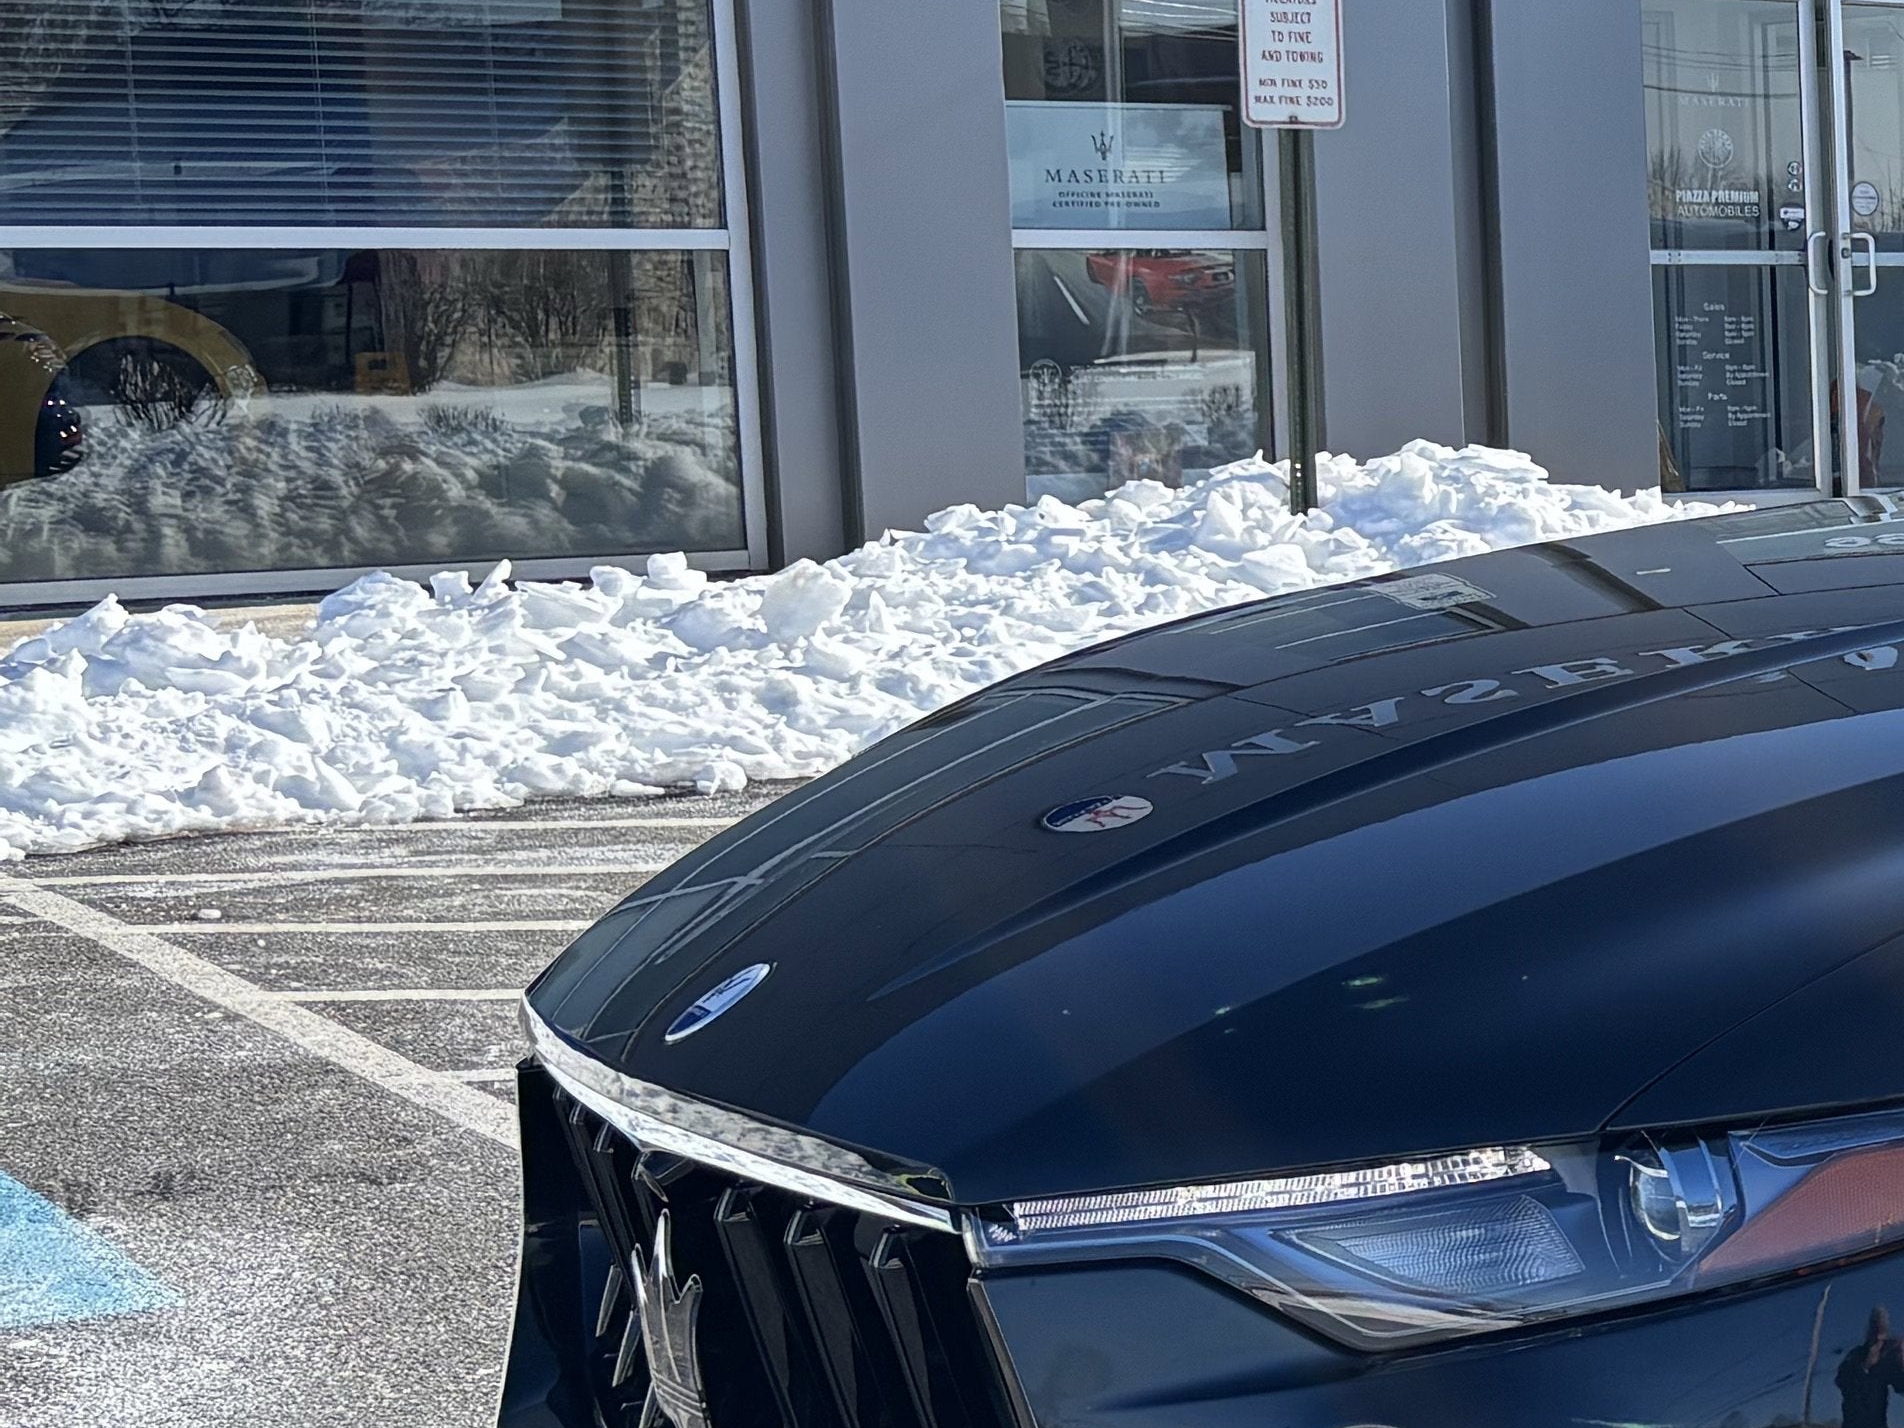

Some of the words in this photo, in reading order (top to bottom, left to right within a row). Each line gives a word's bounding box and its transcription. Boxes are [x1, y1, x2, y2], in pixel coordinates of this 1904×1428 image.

[1270, 12, 1311, 24] SUBJECT
[1271, 30, 1284, 42] TO
[1288, 31, 1312, 44] FINE
[1261, 50, 1282, 62] AND
[1285, 50, 1323, 63] TOWING
[1045, 169, 1167, 184] MASERATI
[1675, 190, 1710, 203] PIAZZA
[1711, 190, 1759, 203] PREMIUM
[1677, 205, 1760, 217] AUTOMOBILES
